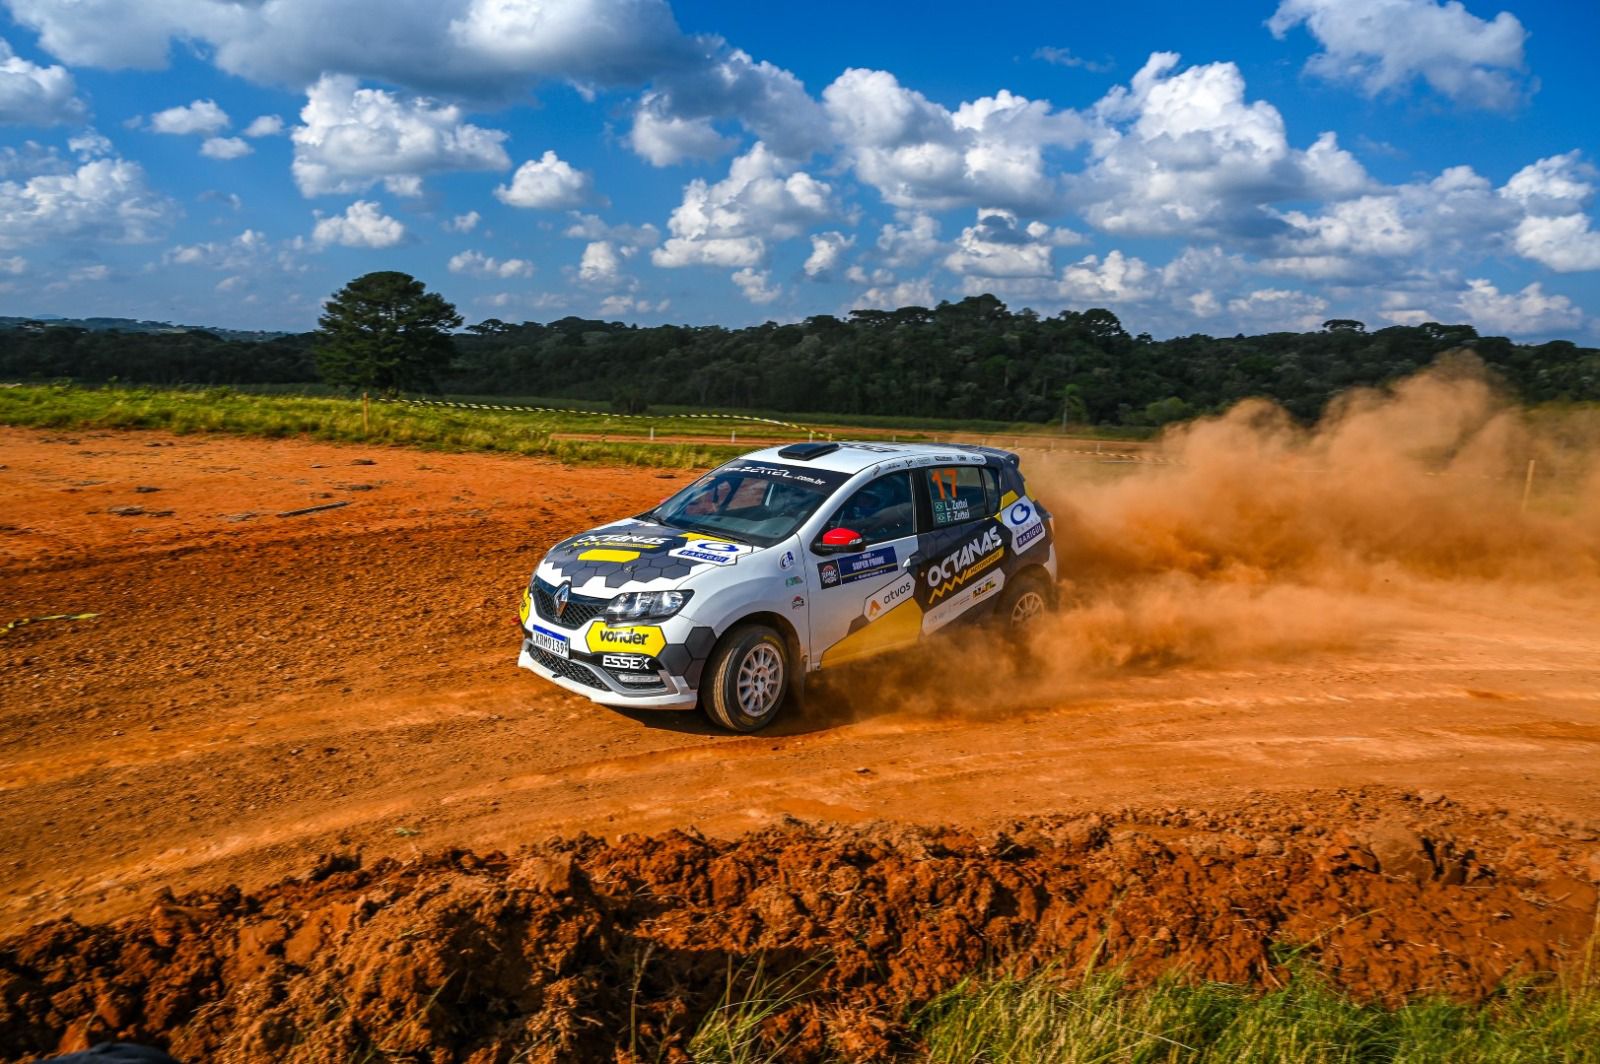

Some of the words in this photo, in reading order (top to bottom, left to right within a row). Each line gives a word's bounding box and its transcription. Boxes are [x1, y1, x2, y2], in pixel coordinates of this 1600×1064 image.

[931, 468, 957, 500] 17
[927, 526, 1001, 587] OCTANAS
[883, 581, 911, 605] atvos
[599, 628, 649, 646] vonder
[602, 655, 650, 669] ESSEX
